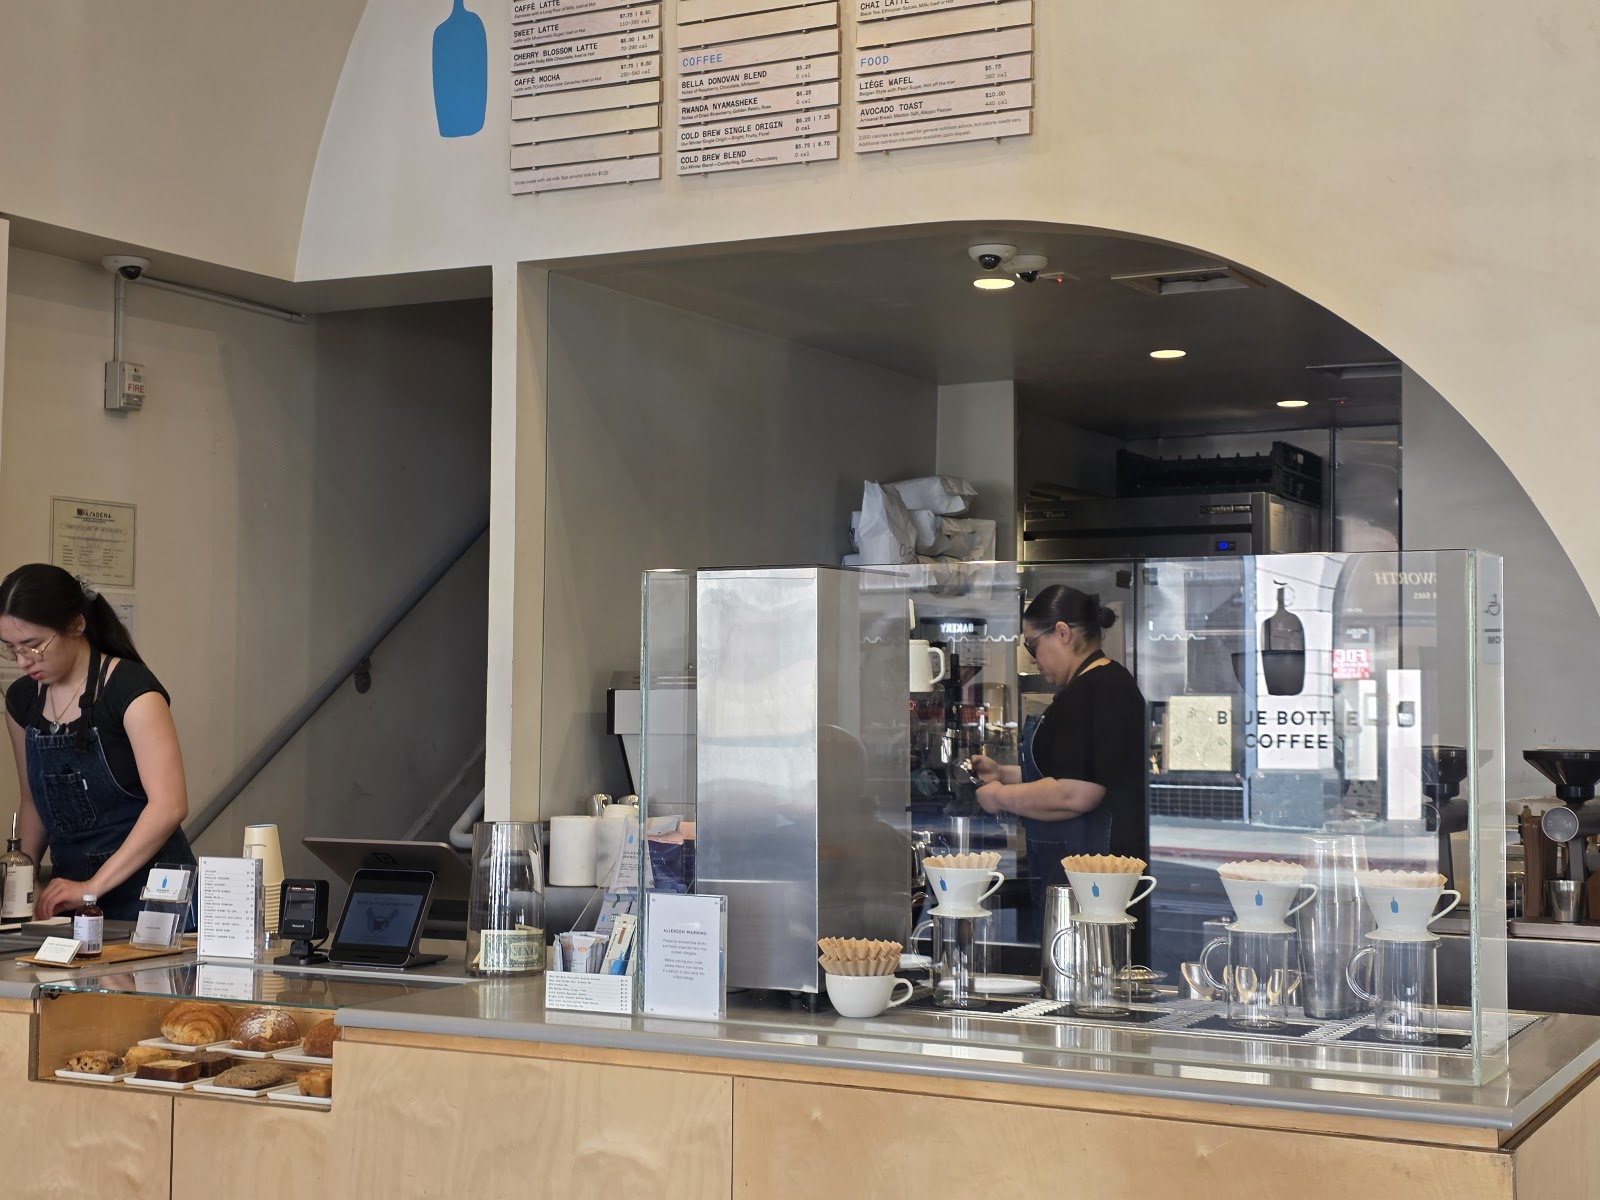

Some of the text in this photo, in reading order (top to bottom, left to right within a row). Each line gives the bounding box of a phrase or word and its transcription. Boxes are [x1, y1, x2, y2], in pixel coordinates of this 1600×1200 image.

[514, 0, 560, 13] CAFFÈ LATTE
[860, 1, 880, 11] CHAI
[514, 24, 559, 37] SWEET LATTE
[514, 43, 598, 61] CHERRY BLOSSOM LATTE
[682, 54, 723, 67] COFFEE
[860, 56, 889, 67] FOOD
[514, 73, 560, 86] CAFFÈ MOCHA
[682, 71, 767, 88] BELLA DONOVAN BLEND
[860, 76, 913, 90] LIÈGE WAFEL
[985, 90, 1006, 98] $10.00
[682, 98, 758, 114] RWANDA NYAMASHEKE
[860, 101, 923, 116] AVOCADO TOAST
[681, 121, 783, 140] COLD BREW SINGLE ORIGIN
[680, 150, 746, 164] COLD BREW BLEND
[128, 383, 144, 393] FIRE
[1277, 710, 1358, 726] BOTTE
[1246, 734, 1328, 748] COFFEE
